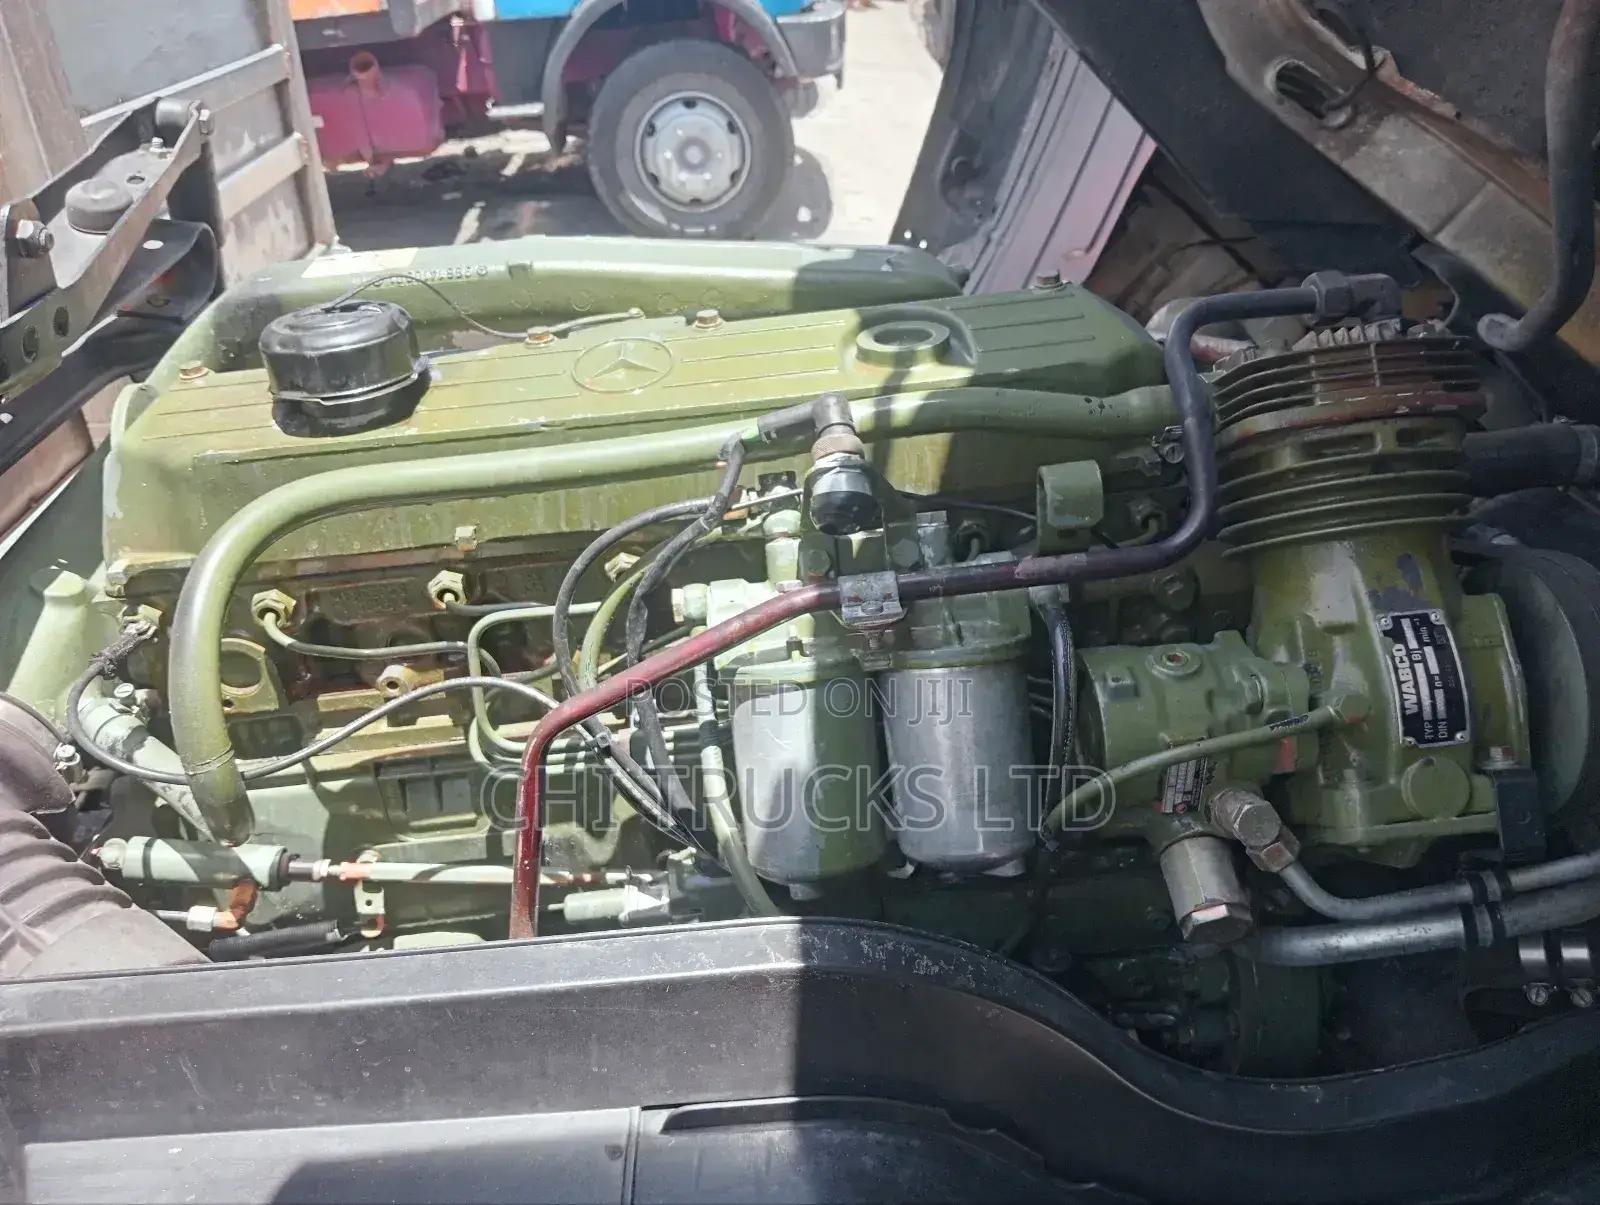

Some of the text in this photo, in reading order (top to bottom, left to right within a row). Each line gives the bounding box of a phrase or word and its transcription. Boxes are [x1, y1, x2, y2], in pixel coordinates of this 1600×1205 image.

[1392, 643, 1419, 716] WABCO
[1424, 721, 1434, 740] TYP
[1438, 721, 1448, 738] DIN
